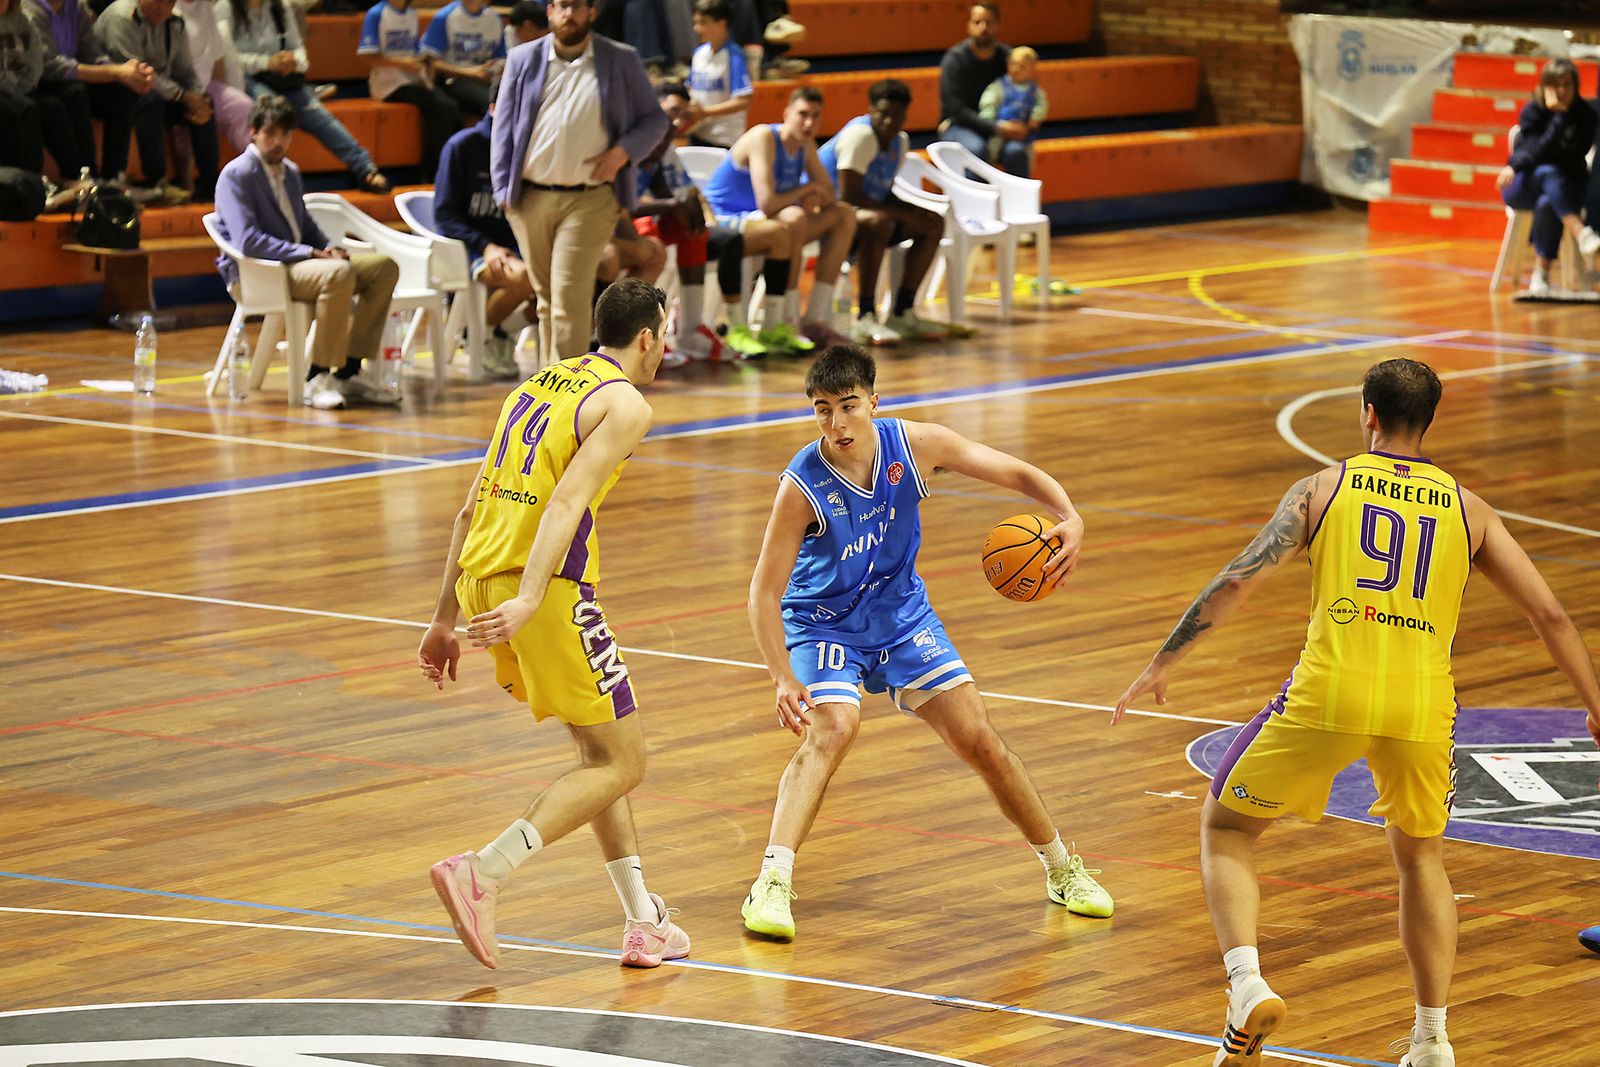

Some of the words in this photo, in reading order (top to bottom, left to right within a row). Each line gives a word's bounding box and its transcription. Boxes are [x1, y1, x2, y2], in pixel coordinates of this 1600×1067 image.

[1351, 474, 1452, 509] BARBECHO
[859, 504, 886, 523] Huelva
[1356, 502, 1438, 601] 91
[1327, 607, 1361, 616] NISSAN
[815, 641, 846, 671] 10
